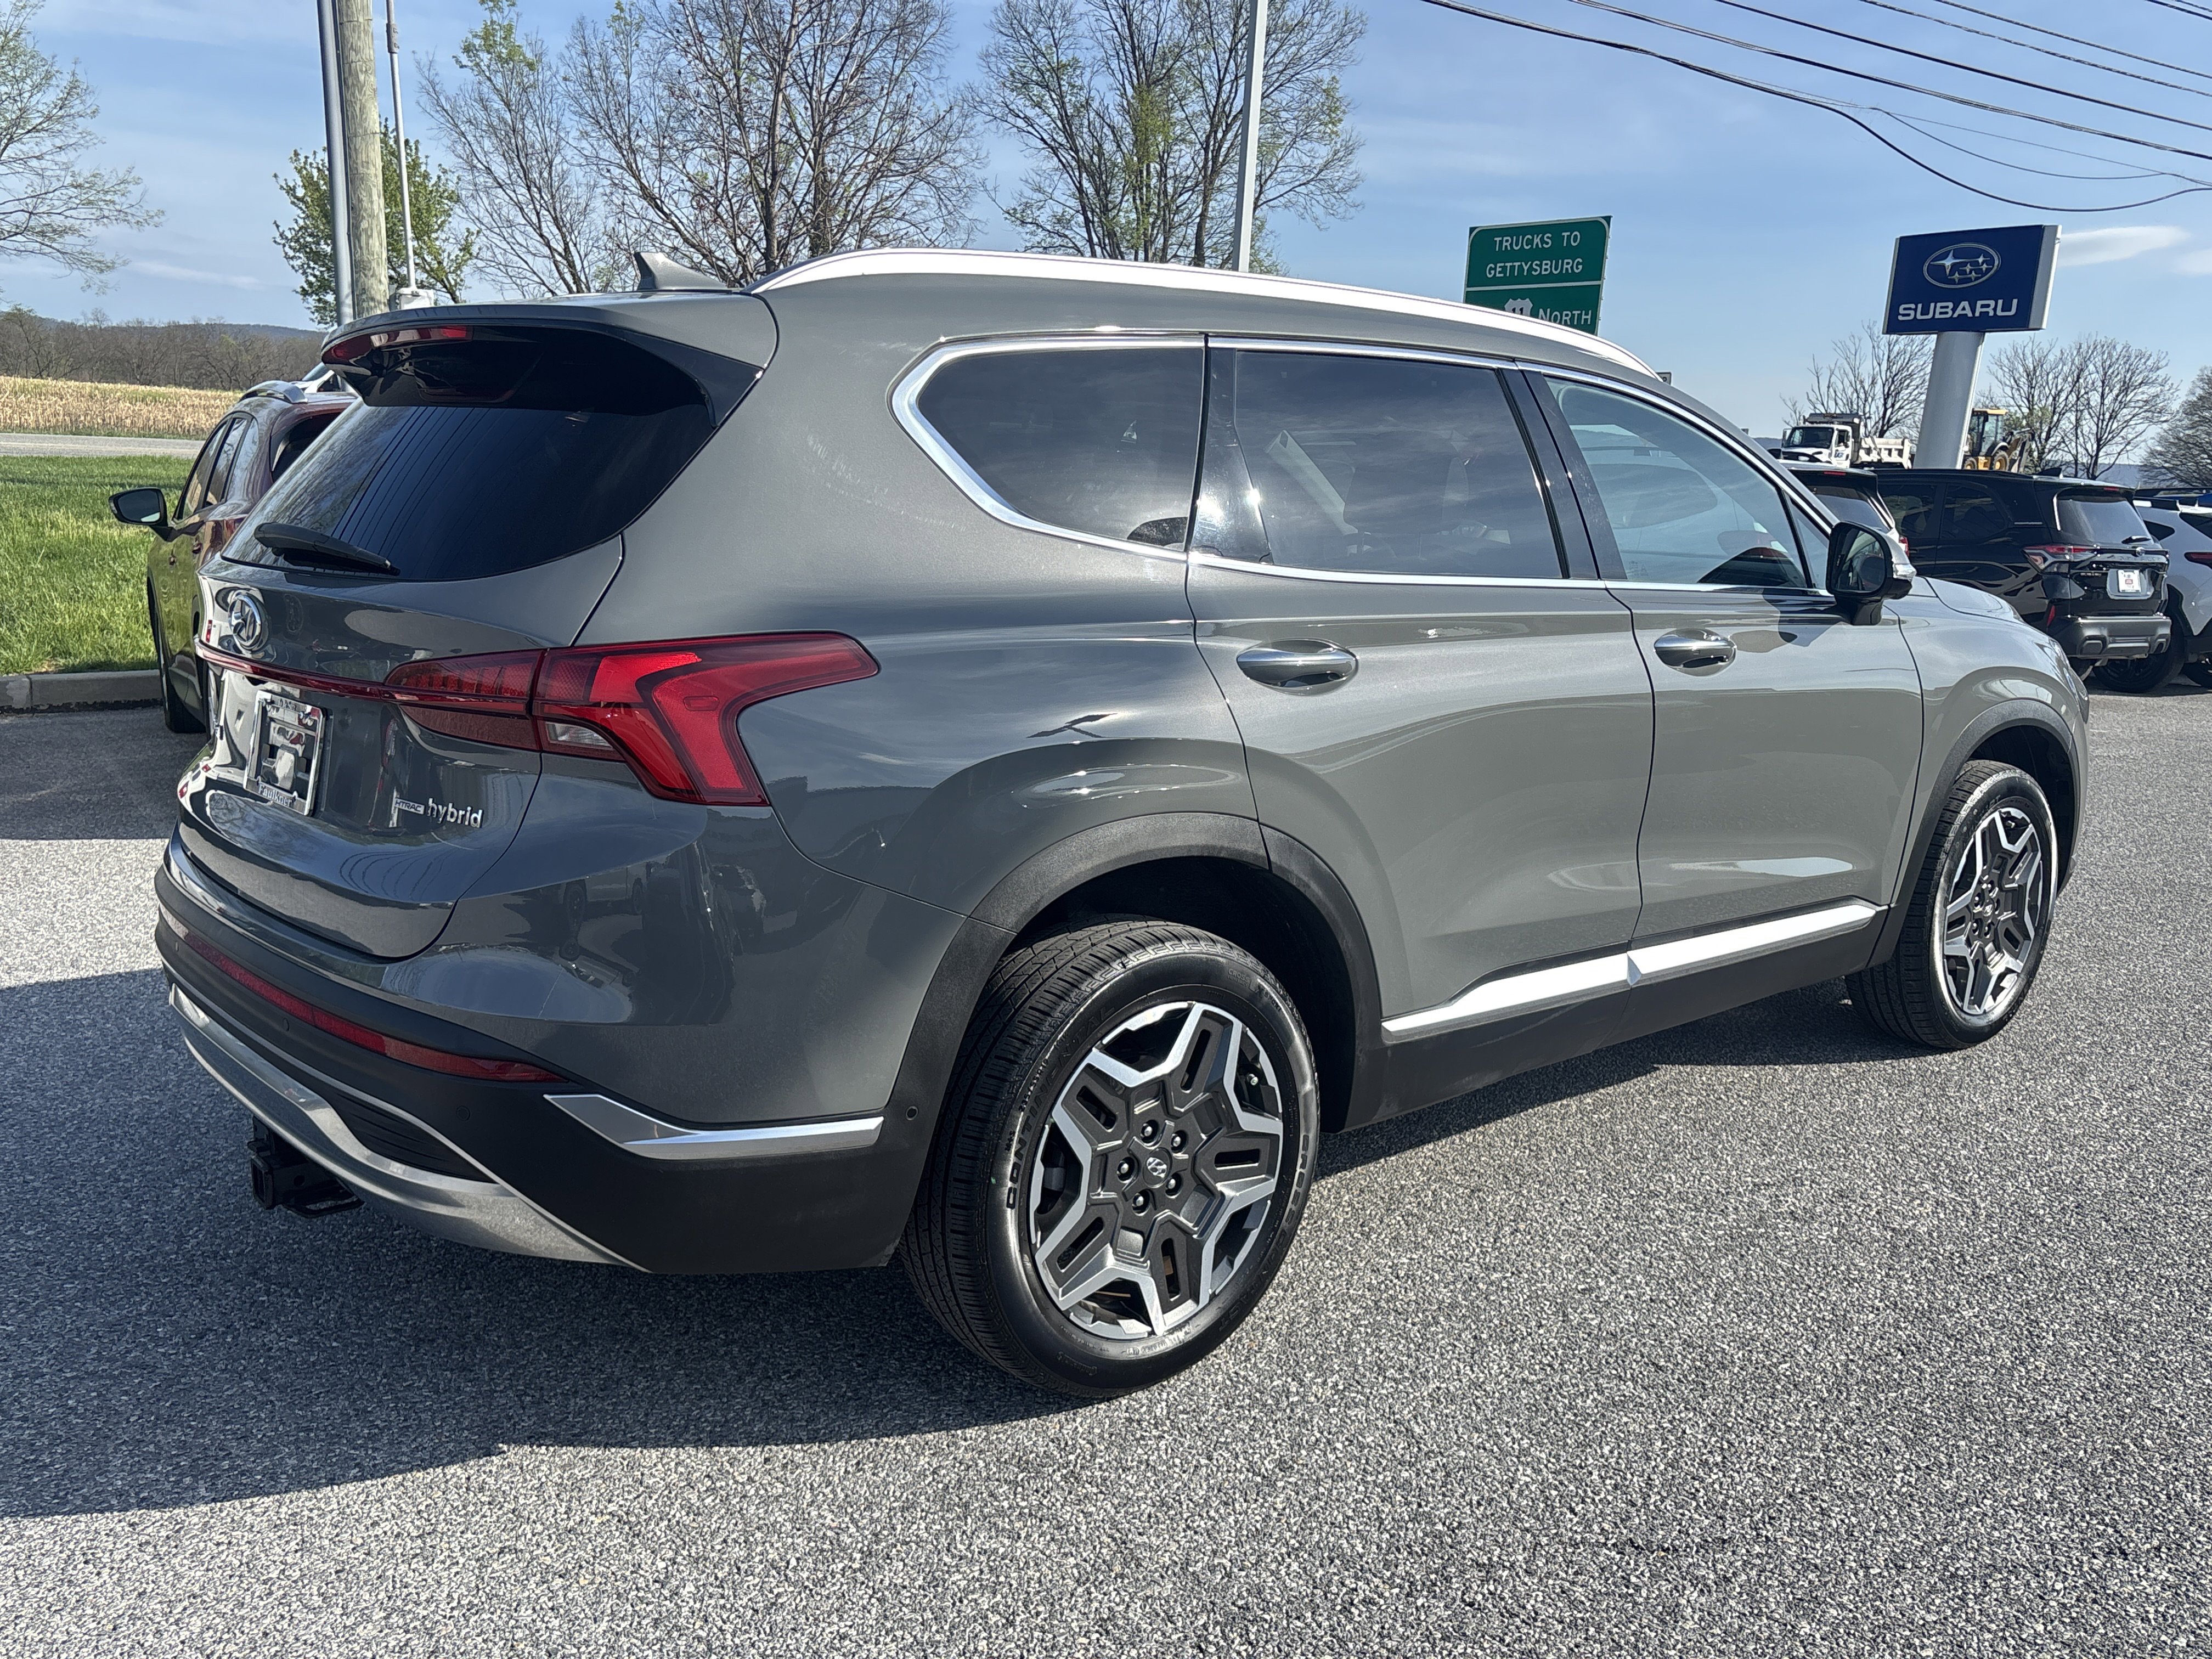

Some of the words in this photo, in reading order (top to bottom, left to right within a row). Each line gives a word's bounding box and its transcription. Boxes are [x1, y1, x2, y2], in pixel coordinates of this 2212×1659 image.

[1494, 233, 1551, 251] TRUCKS
[1561, 231, 1581, 247] TO
[1486, 258, 1583, 278] GETTYSBURG
[1538, 308, 1592, 325] NORTH
[1898, 298, 2018, 321] SUBARU
[258, 783, 292, 807] Faulkner
[395, 799, 422, 812] HTRAC
[427, 797, 484, 828] hybrid
